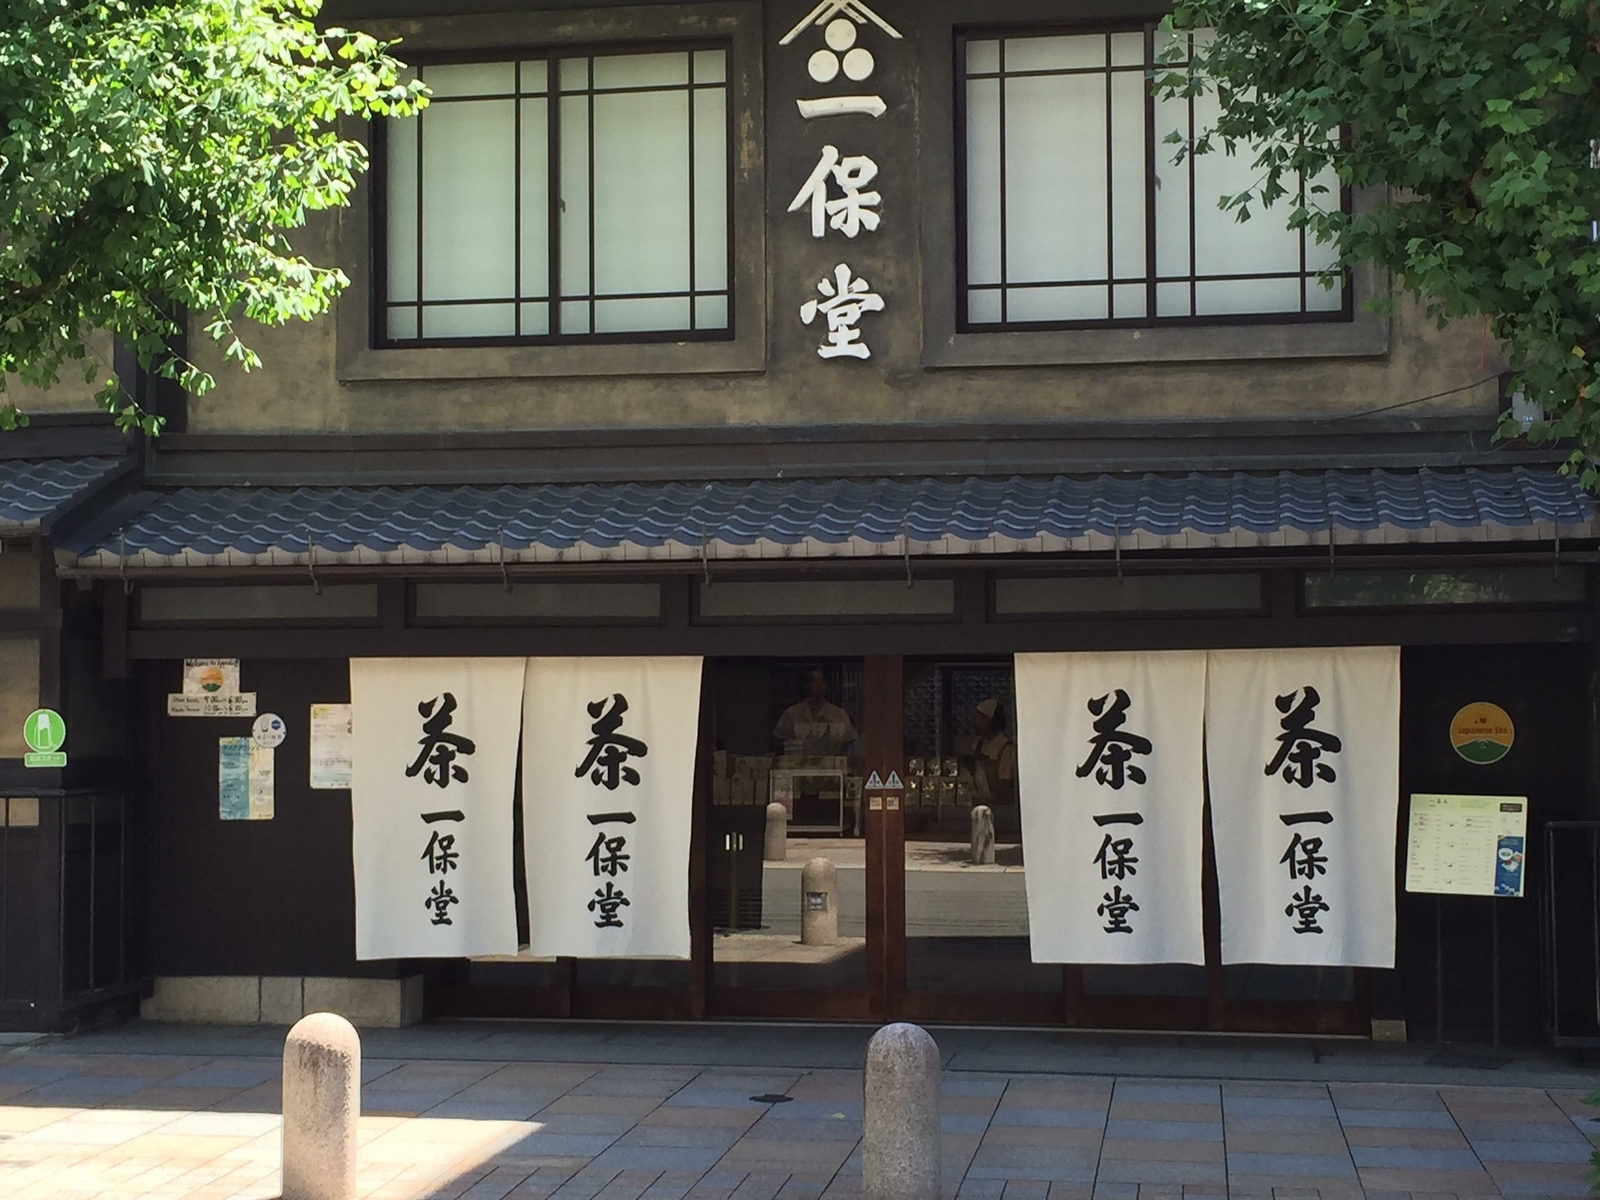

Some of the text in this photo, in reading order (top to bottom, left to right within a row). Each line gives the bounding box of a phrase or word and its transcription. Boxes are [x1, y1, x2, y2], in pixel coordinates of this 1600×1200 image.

[787, 95, 887, 359] 一保堂
[404, 692, 476, 926] 茶一保堂
[574, 693, 649, 929] 茶一保堂
[1075, 688, 1153, 935] 茶一保堂
[1264, 685, 1343, 935] 茶一保堂
[1457, 726, 1493, 736] Japanese
